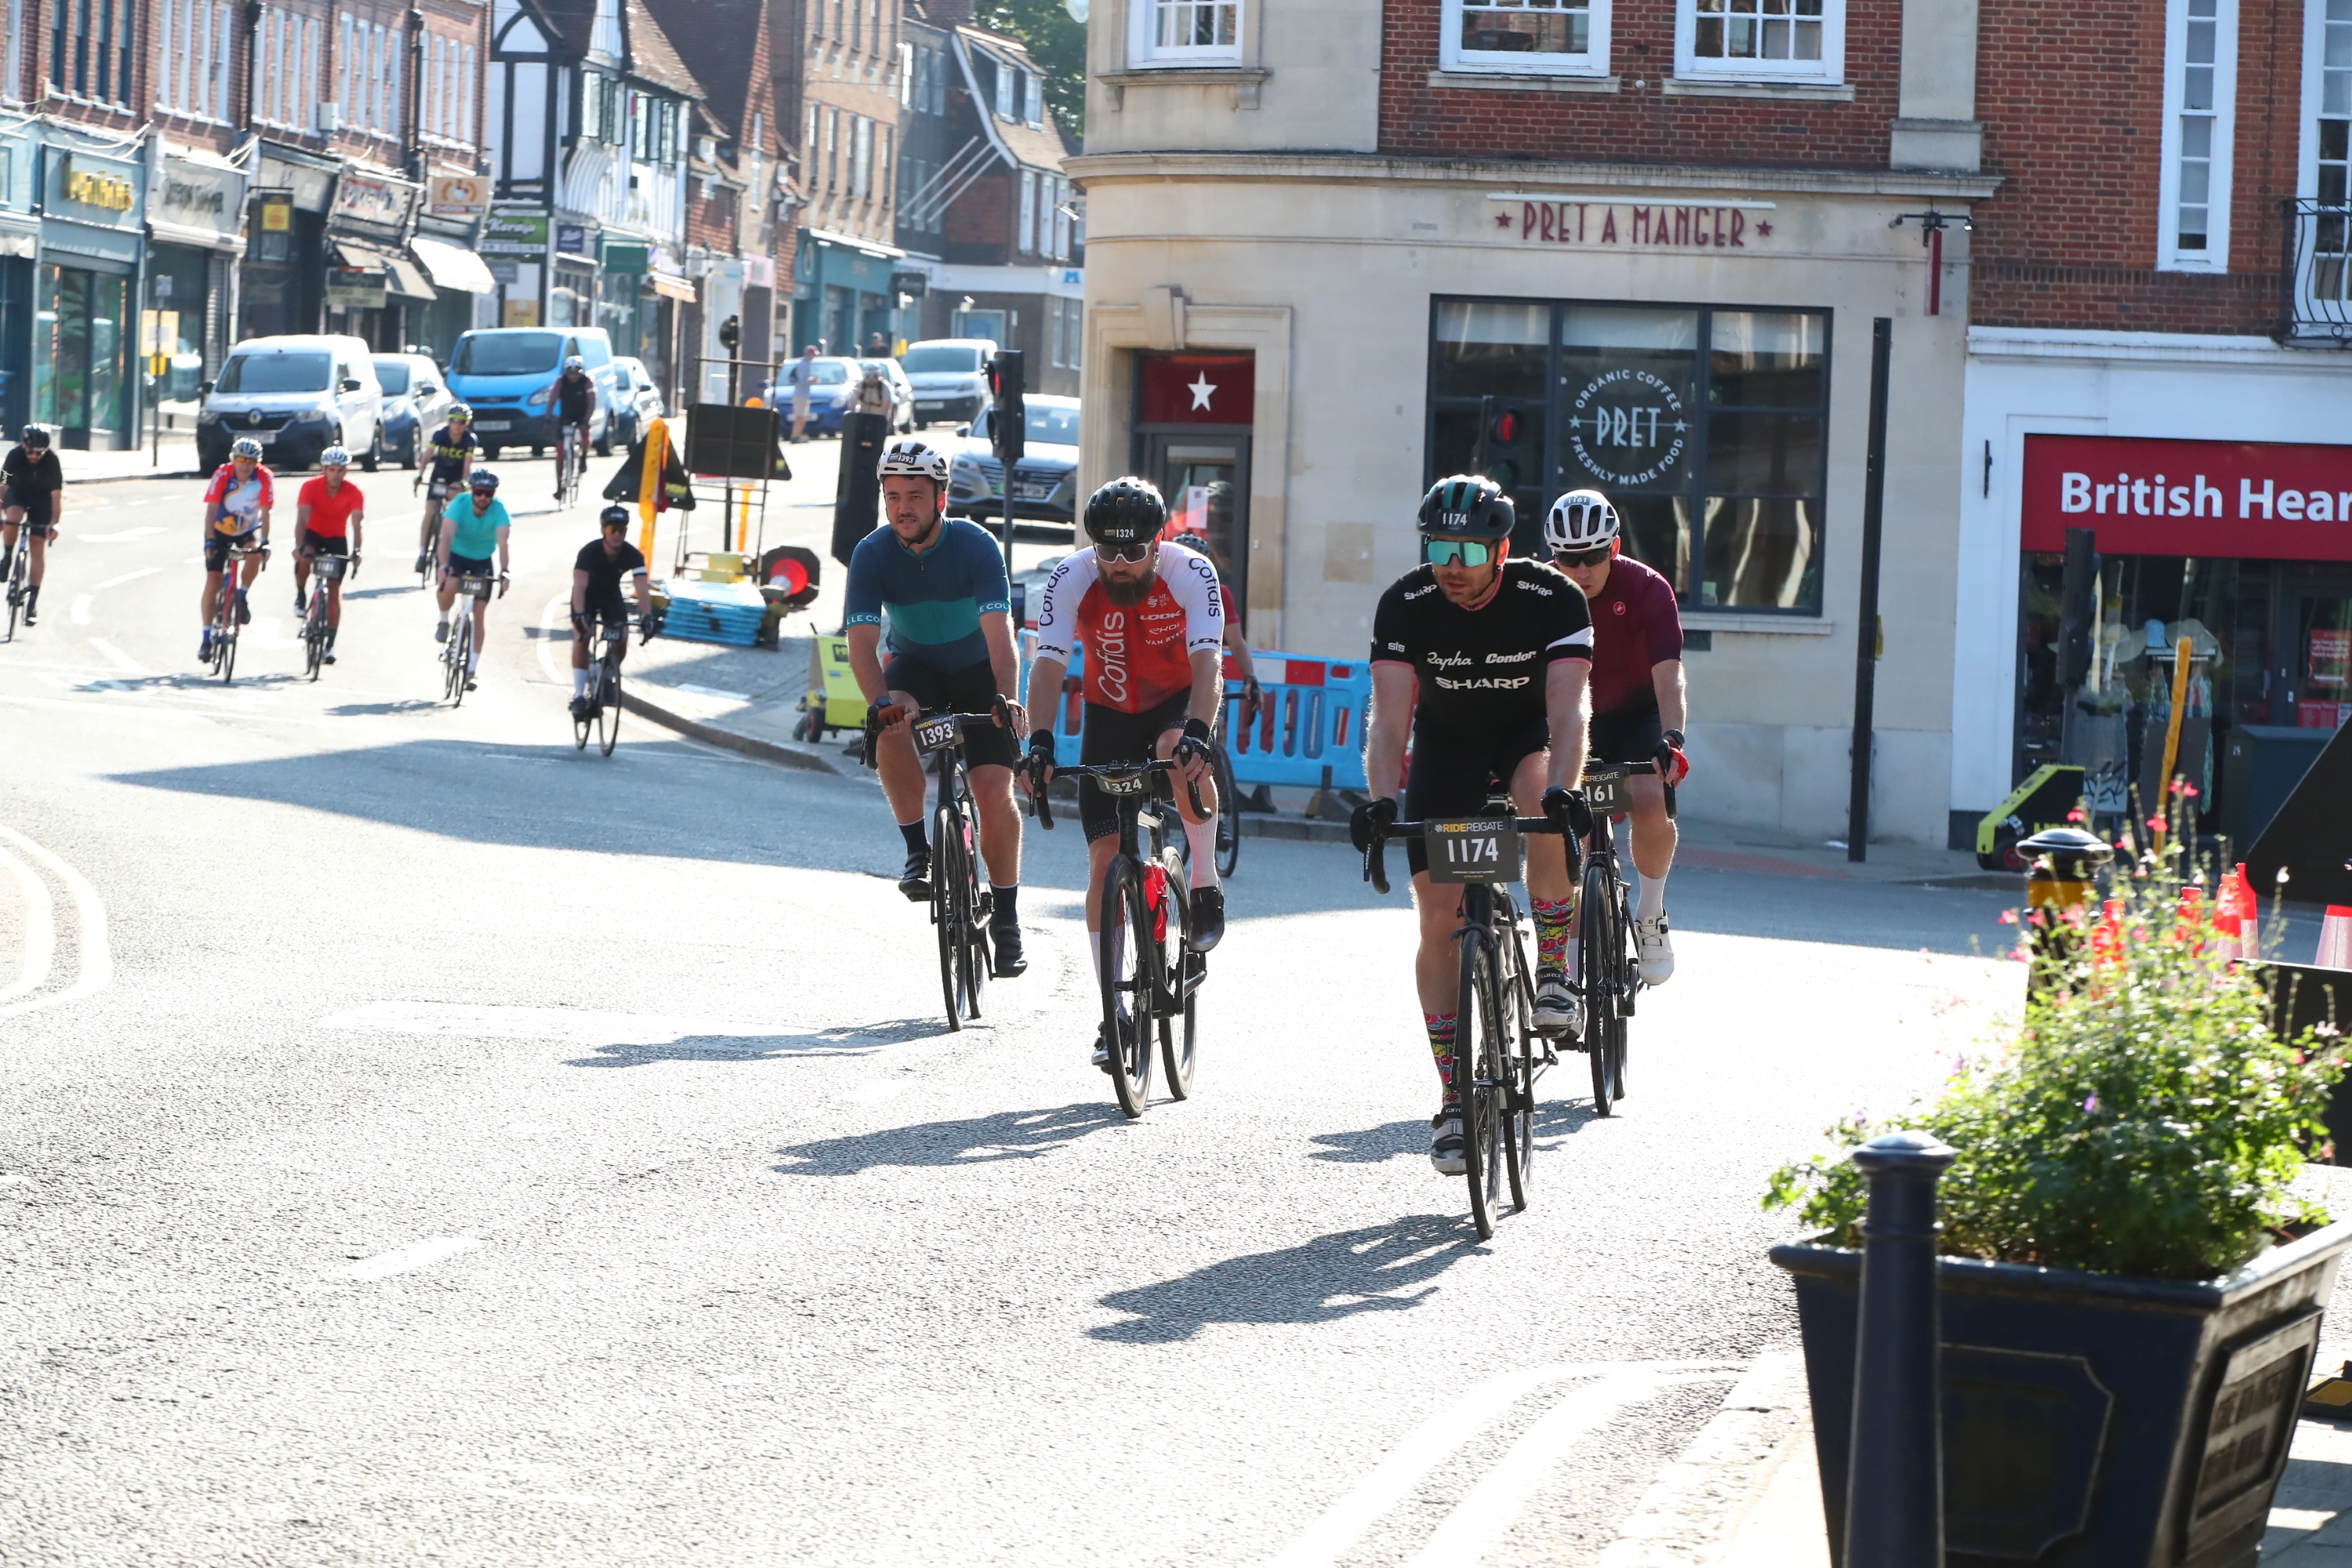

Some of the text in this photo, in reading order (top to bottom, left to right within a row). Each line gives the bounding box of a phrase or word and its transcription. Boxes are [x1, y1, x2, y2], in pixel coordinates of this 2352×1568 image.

[1523, 202, 1745, 247] PRET A MANGER
[1575, 369, 1682, 411] ORGANIC COFFEE
[1596, 405, 1661, 448] PRET
[898, 455, 914, 463] 1393
[1570, 436, 1683, 485] FRESHLY MADE FOOD
[2061, 472, 2223, 517] British
[1442, 513, 1467, 526] 1174
[1116, 528, 1134, 538] 1324
[1039, 564, 1069, 626] Cofidis
[1189, 557, 1221, 618] Cofidis
[1404, 584, 1437, 601] SHARP
[1517, 580, 1553, 597] SHARP
[1140, 609, 1181, 620] LOOK
[1096, 611, 1127, 702] Cofidis
[1427, 651, 1534, 670] Rapha Condor
[1435, 677, 1530, 689] SHARP
[920, 723, 953, 746] 1393
[1104, 778, 1143, 792] 1324
[1443, 821, 1504, 833] RIDEREIGATE
[1447, 837, 1498, 862] 1174
